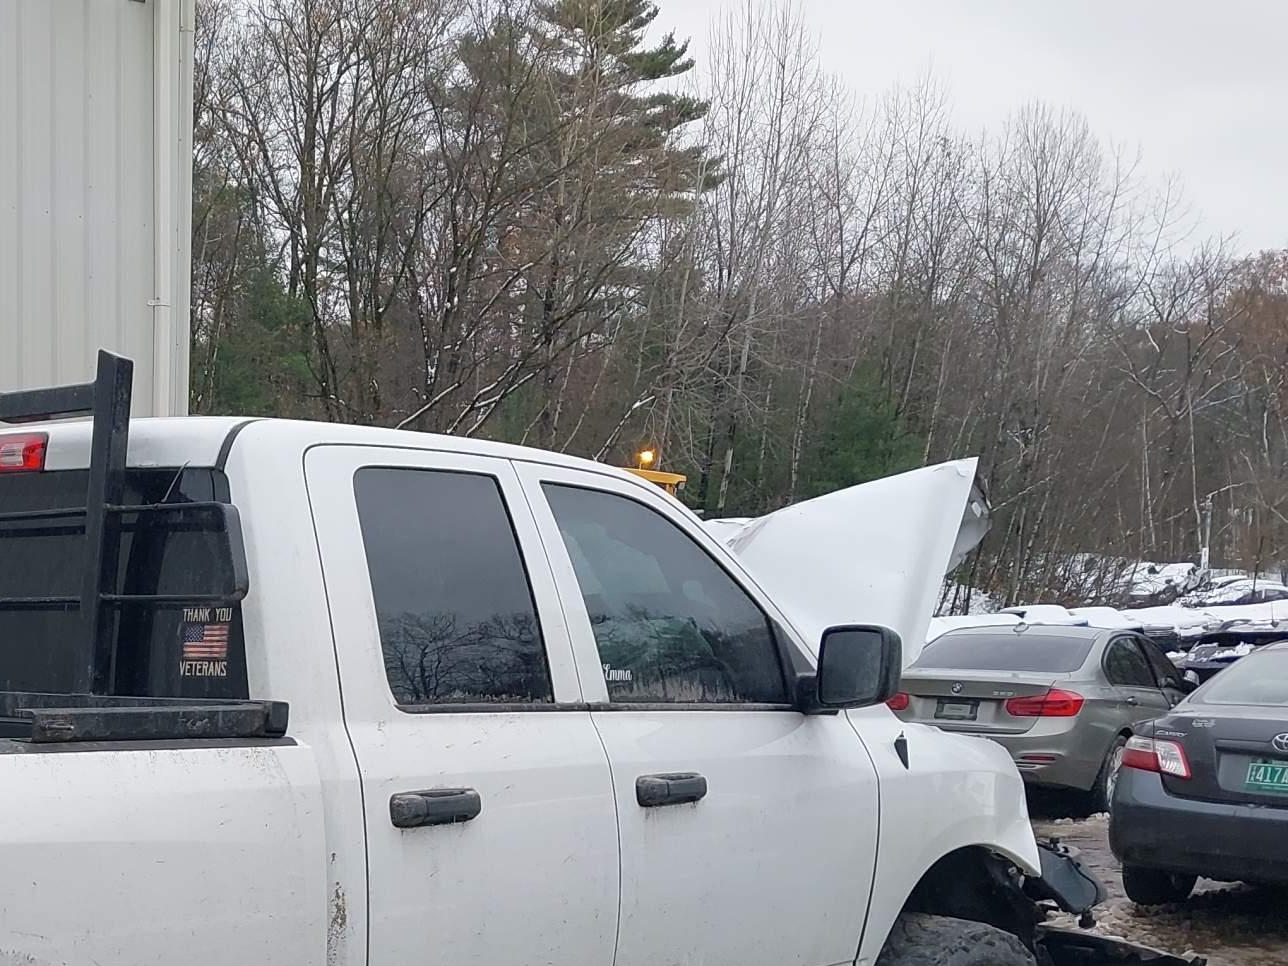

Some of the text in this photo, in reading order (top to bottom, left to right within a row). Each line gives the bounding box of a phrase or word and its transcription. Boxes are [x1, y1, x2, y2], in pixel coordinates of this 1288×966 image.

[183, 608, 232, 621] THANK YOU
[179, 661, 228, 676] VETERANS
[602, 663, 632, 681] Emma
